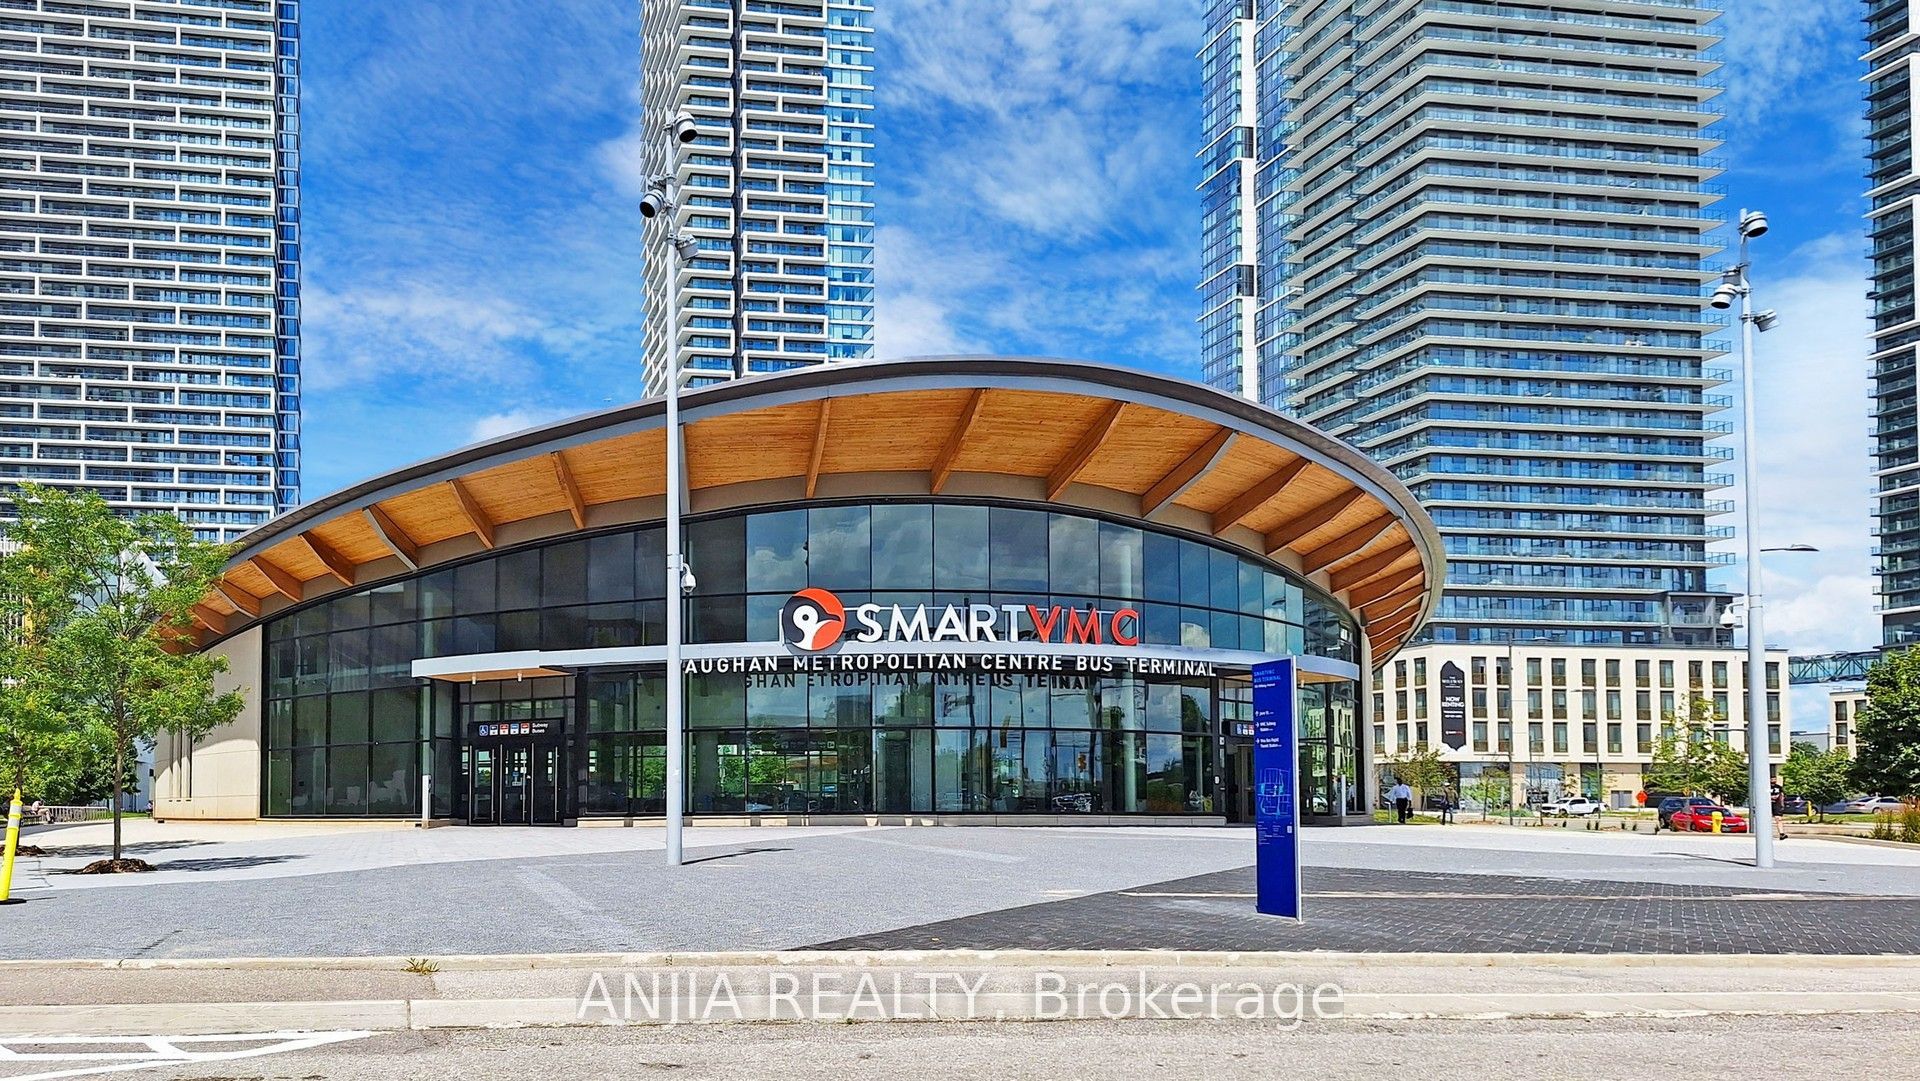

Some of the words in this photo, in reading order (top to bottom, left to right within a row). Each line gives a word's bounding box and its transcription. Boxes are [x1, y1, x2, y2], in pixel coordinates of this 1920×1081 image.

[684, 656, 778, 674] AUGHAN
[793, 653, 966, 672] METROPOLITAN
[980, 653, 1063, 671] CENTRE
[1075, 655, 1113, 672] BUS
[1126, 657, 1217, 677] TERMINAL
